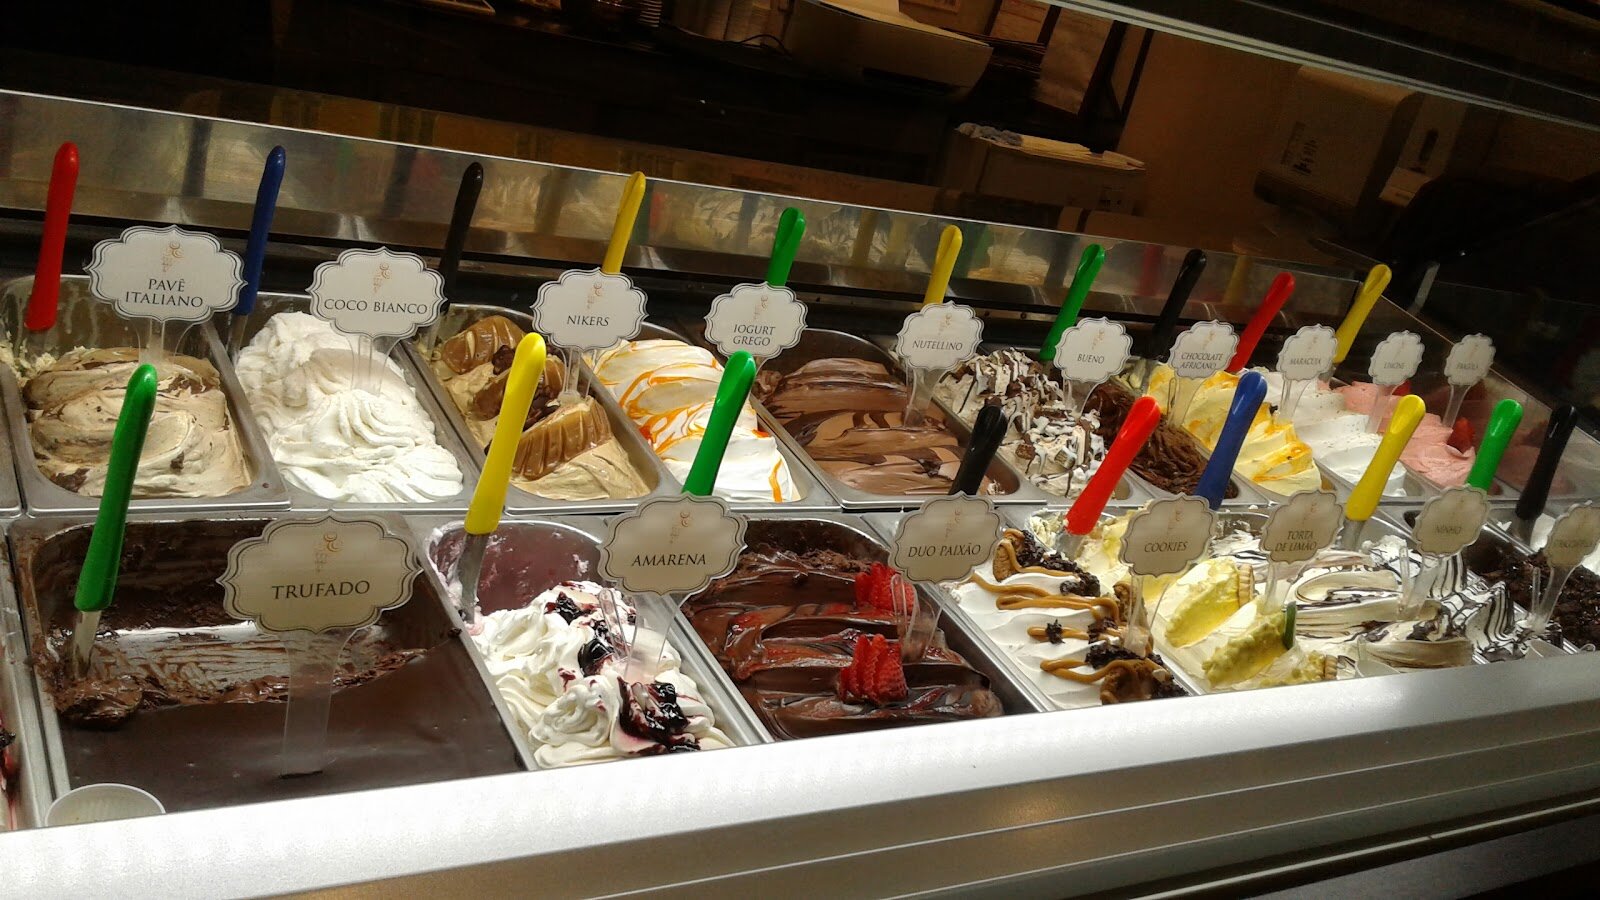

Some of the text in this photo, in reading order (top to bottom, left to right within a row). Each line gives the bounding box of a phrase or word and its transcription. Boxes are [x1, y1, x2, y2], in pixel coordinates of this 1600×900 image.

[148, 277, 186, 292] PAVÊ
[125, 291, 204, 308] ITALIANO
[324, 298, 428, 315] COCO BIANCO
[566, 315, 610, 327] NIKERS
[733, 324, 776, 336] IOGURT
[733, 336, 771, 347] GREGO
[912, 340, 963, 351] NUTELLINO
[1077, 353, 1105, 364] BUENO
[1181, 352, 1224, 361] CHOCOLATE
[1180, 361, 1217, 370] AFRICANO
[1287, 530, 1313, 540] TORTA
[908, 542, 981, 558] DUO PAIXÃO
[1143, 541, 1188, 553] COOKIES
[1275, 542, 1288, 552] DE
[631, 552, 707, 568] AMARENA
[271, 579, 371, 601] TRUFADO
